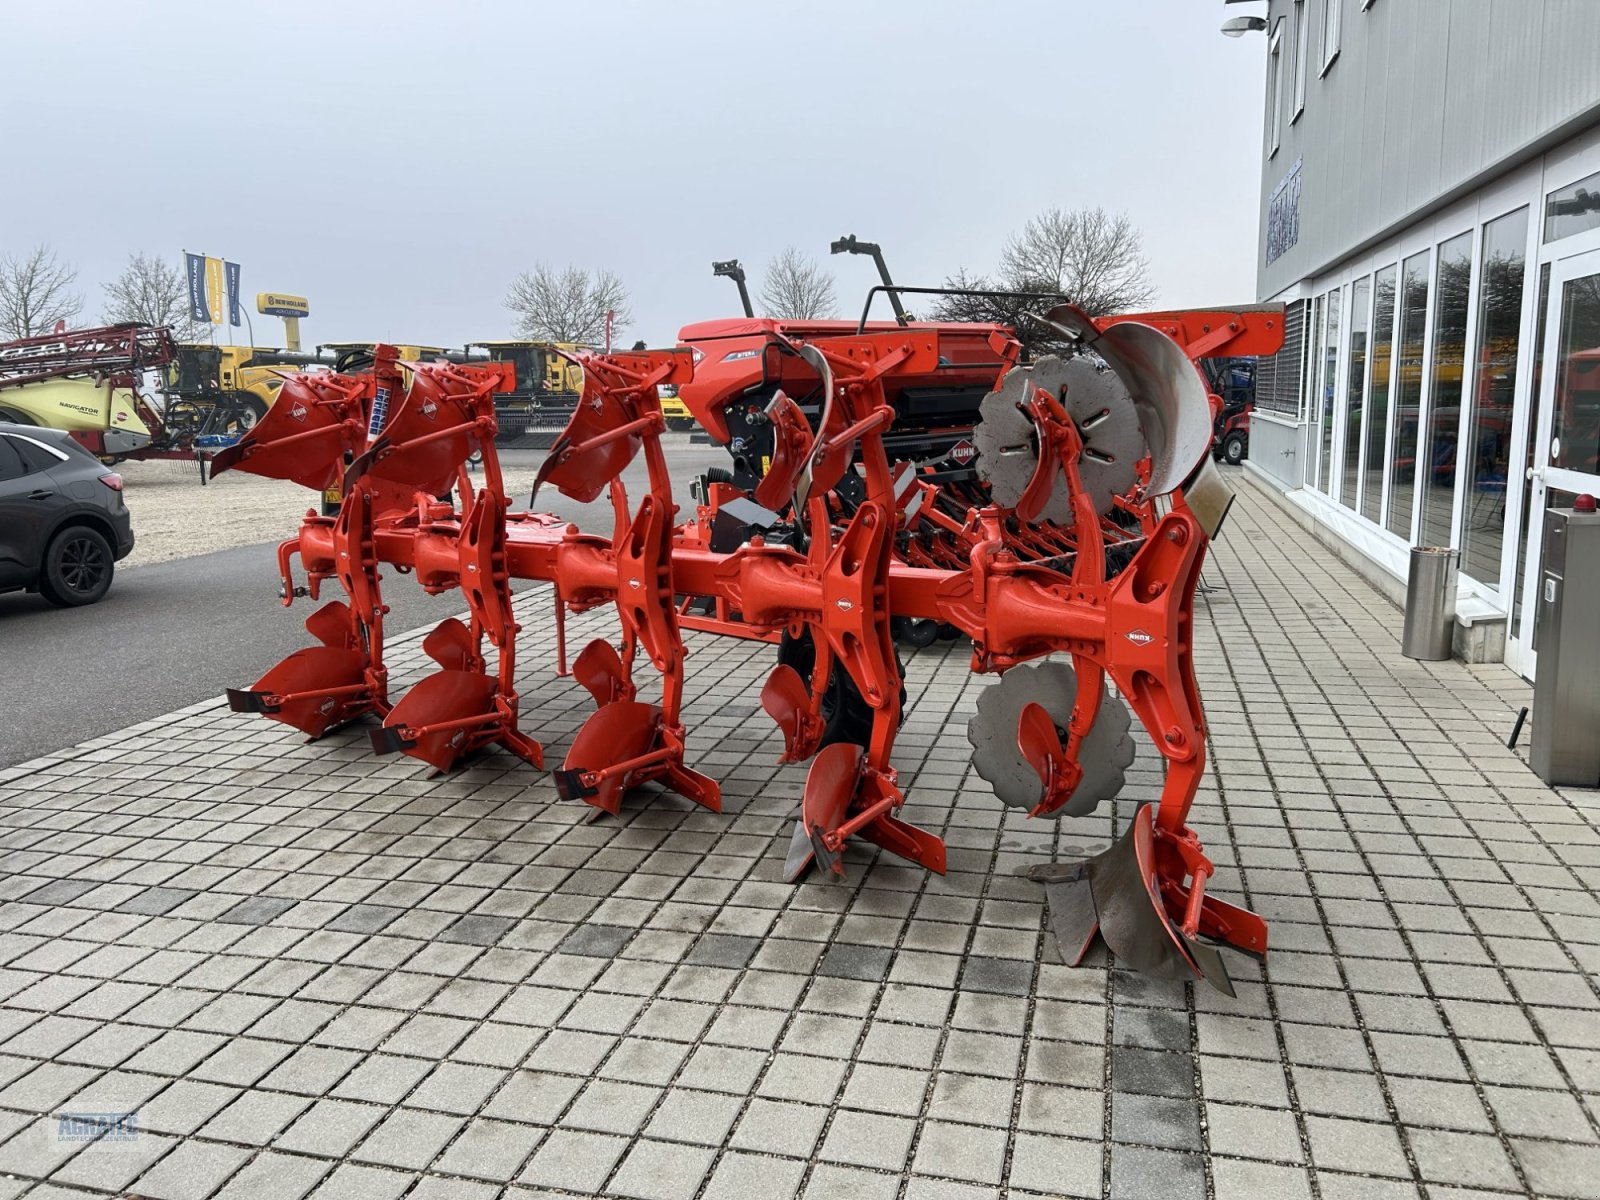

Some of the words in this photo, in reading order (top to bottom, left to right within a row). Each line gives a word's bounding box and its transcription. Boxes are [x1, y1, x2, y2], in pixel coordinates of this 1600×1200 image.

[286, 300, 307, 308] HOLLAND
[59, 402, 99, 414] NAVIGATOR
[952, 447, 975, 457] KUHN
[1129, 633, 1150, 641] KUHN
